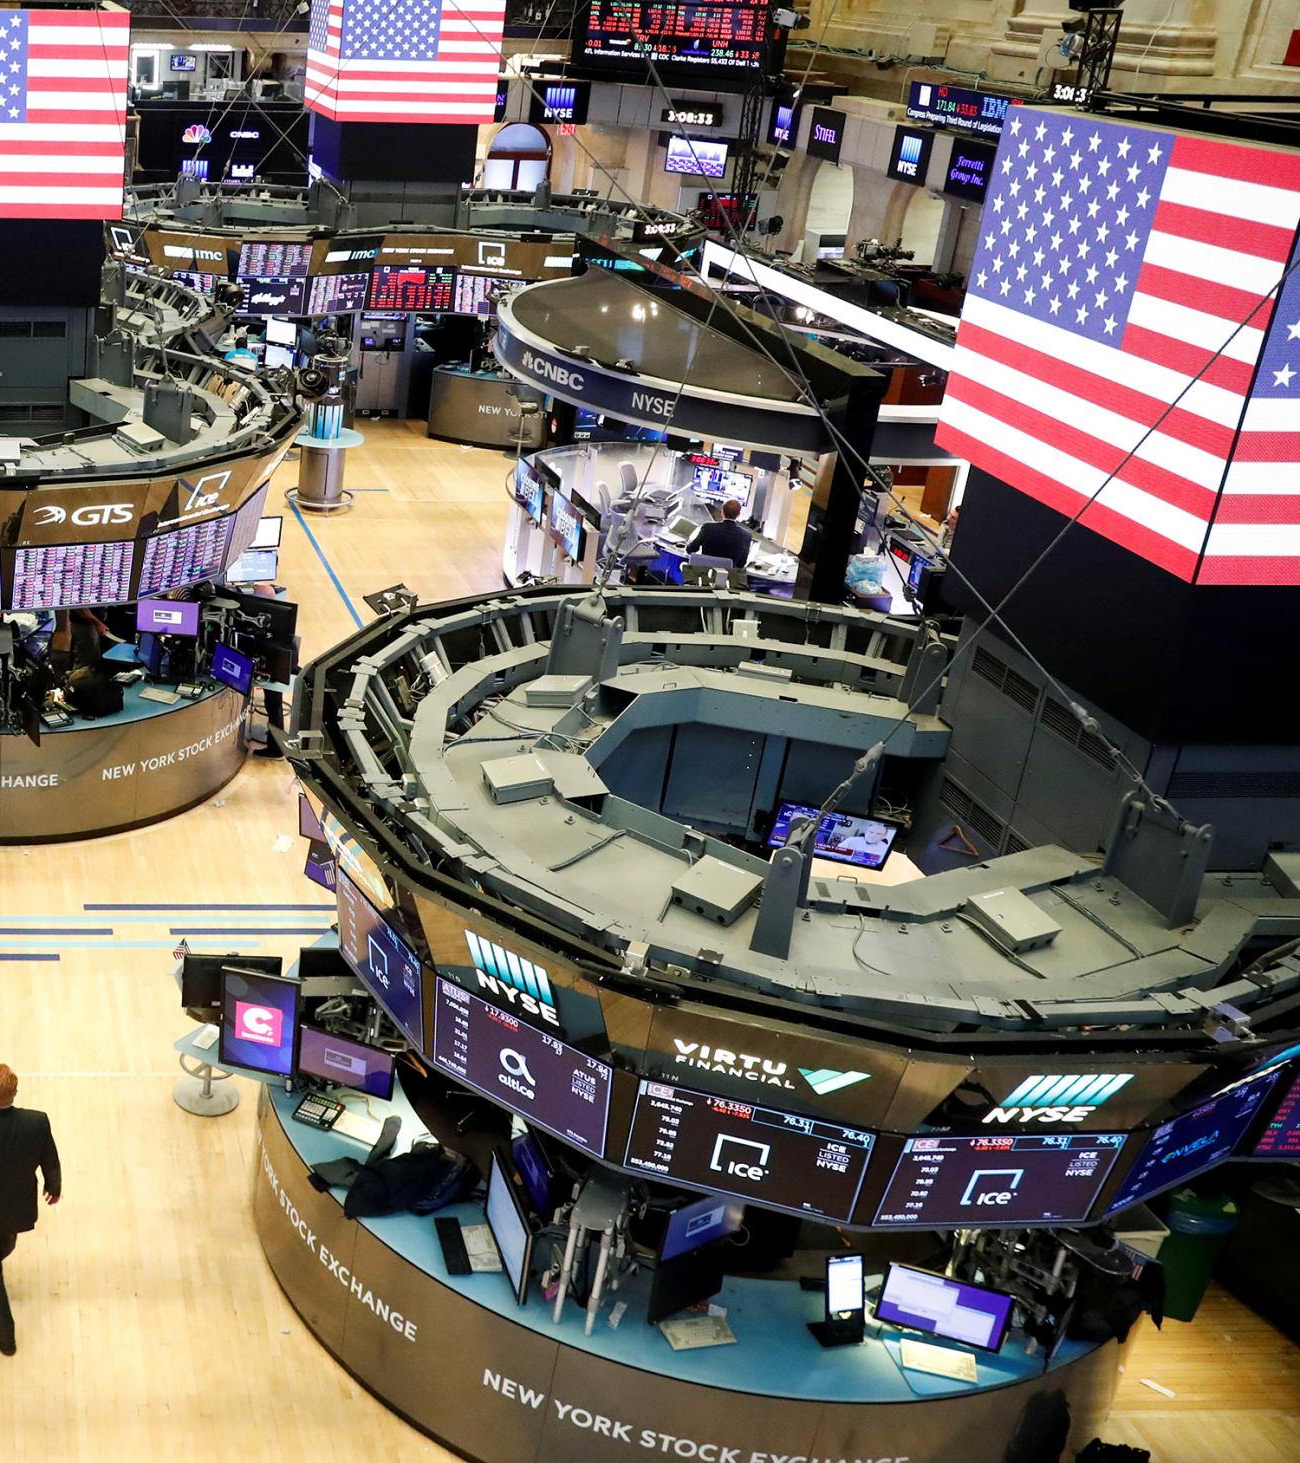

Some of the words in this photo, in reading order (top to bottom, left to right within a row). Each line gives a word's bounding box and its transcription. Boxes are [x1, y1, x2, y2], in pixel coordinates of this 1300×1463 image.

[712, 40, 729, 48] UNH
[711, 49, 734, 57] 238.46
[544, 108, 573, 119] NYSE
[937, 99, 956, 112] 171.84
[981, 97, 1010, 120] IBM
[907, 107, 926, 120] Congress
[926, 111, 946, 124] Preparing
[946, 114, 958, 125] Third
[958, 117, 972, 129] Round
[972, 120, 978, 129] of
[978, 121, 1002, 133] Legislation
[814, 125, 836, 144] STIFEL
[897, 160, 917, 176] NYSE
[957, 156, 985, 171] Ferretti
[950, 171, 970, 185] Group
[972, 174, 984, 186] Inc.
[533, 358, 585, 391] CNBC
[478, 405, 501, 416] NEW
[631, 391, 676, 418] NYSE
[71, 503, 134, 526] GTS
[102, 763, 136, 780] NEW
[140, 752, 175, 772] YORK
[178, 735, 212, 761] STOCK
[214, 705, 252, 745] EXCHANGE
[476, 968, 560, 1027] NYSE
[674, 1039, 787, 1075] VIRTU
[675, 1055, 796, 1089] FINANCIAL
[499, 1074, 536, 1100] altice
[713, 1098, 752, 1114] 76.3350
[981, 1106, 1097, 1124] NYSE
[843, 1129, 870, 1143] 76.40
[827, 1143, 847, 1153] ICE
[816, 1160, 847, 1172] NYSE
[819, 1152, 849, 1163] LISTED
[1065, 1168, 1093, 1177] NYSE
[279, 1189, 317, 1253] STOCK
[319, 1244, 418, 1343] EXCHANGE
[483, 1368, 545, 1410] NEW
[553, 1398, 632, 1444] YORK
[639, 1428, 742, 1463] STOCK
